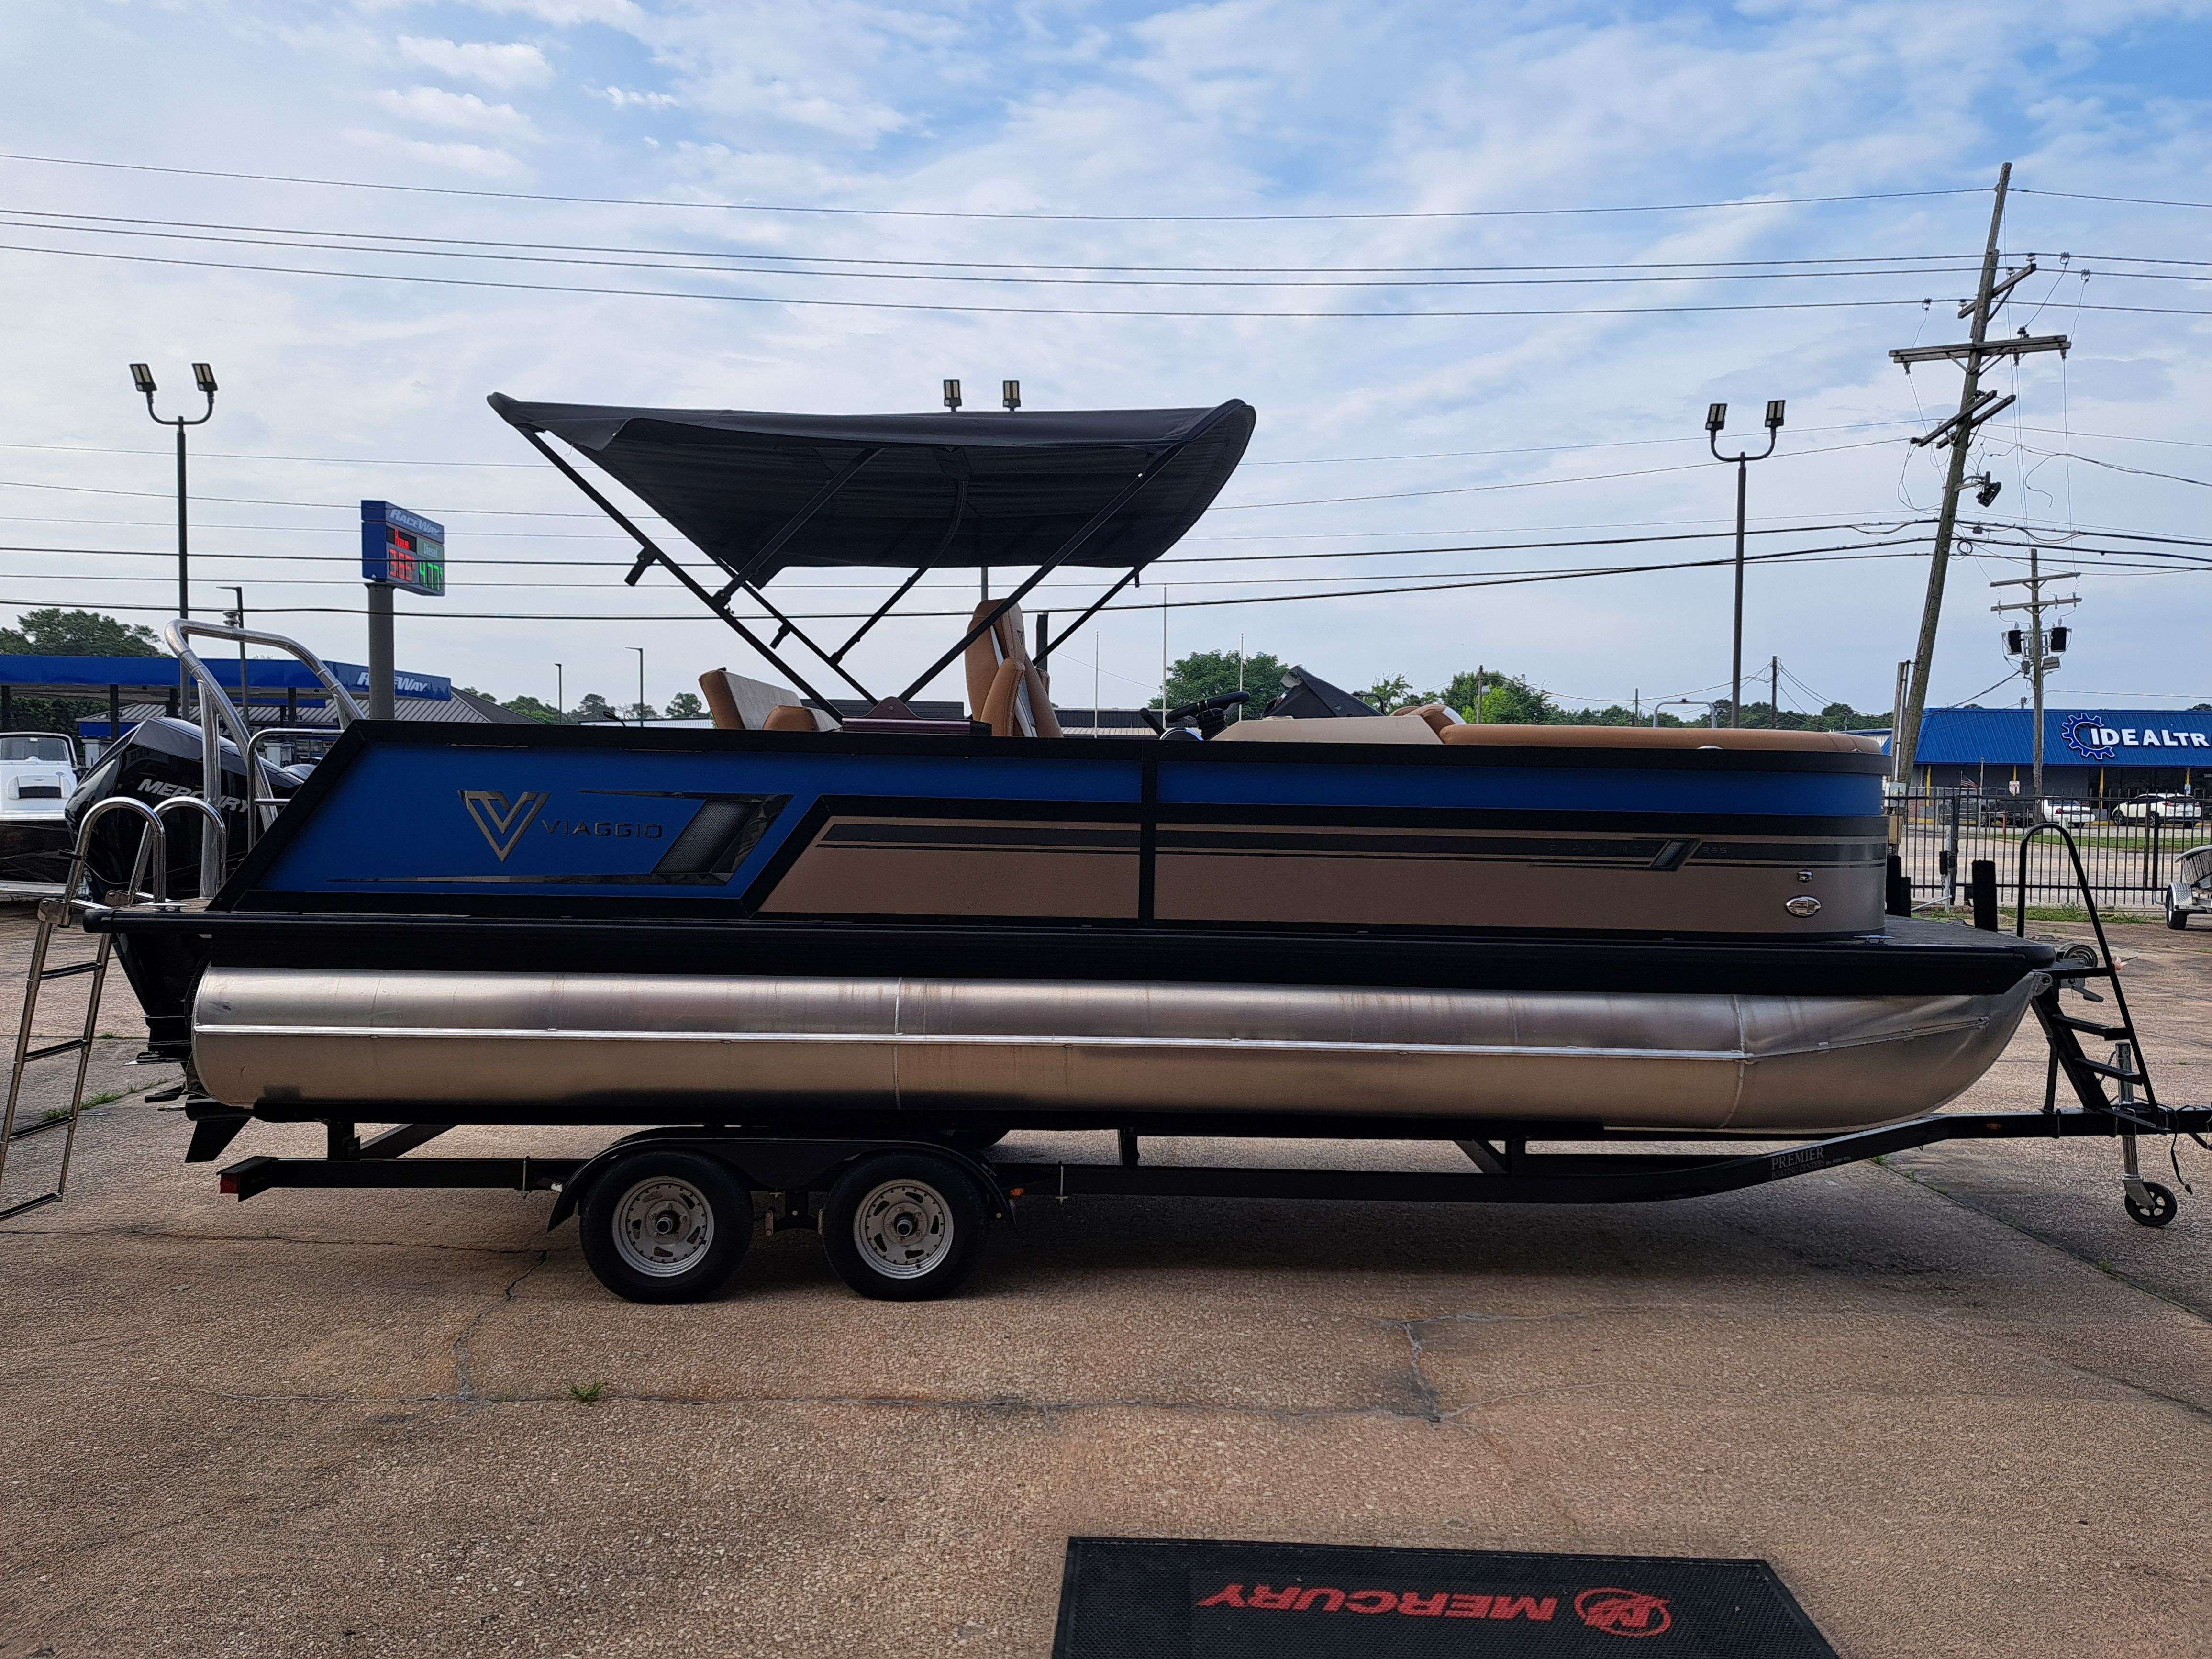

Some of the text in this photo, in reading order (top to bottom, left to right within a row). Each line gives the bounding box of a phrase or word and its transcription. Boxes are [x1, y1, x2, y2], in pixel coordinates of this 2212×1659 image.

[423, 543, 438, 558] Diesel
[541, 819, 663, 839] VIAGGIO
[1771, 1147, 1824, 1170] PREMIER
[1195, 1583, 1560, 1622] MERCURY
